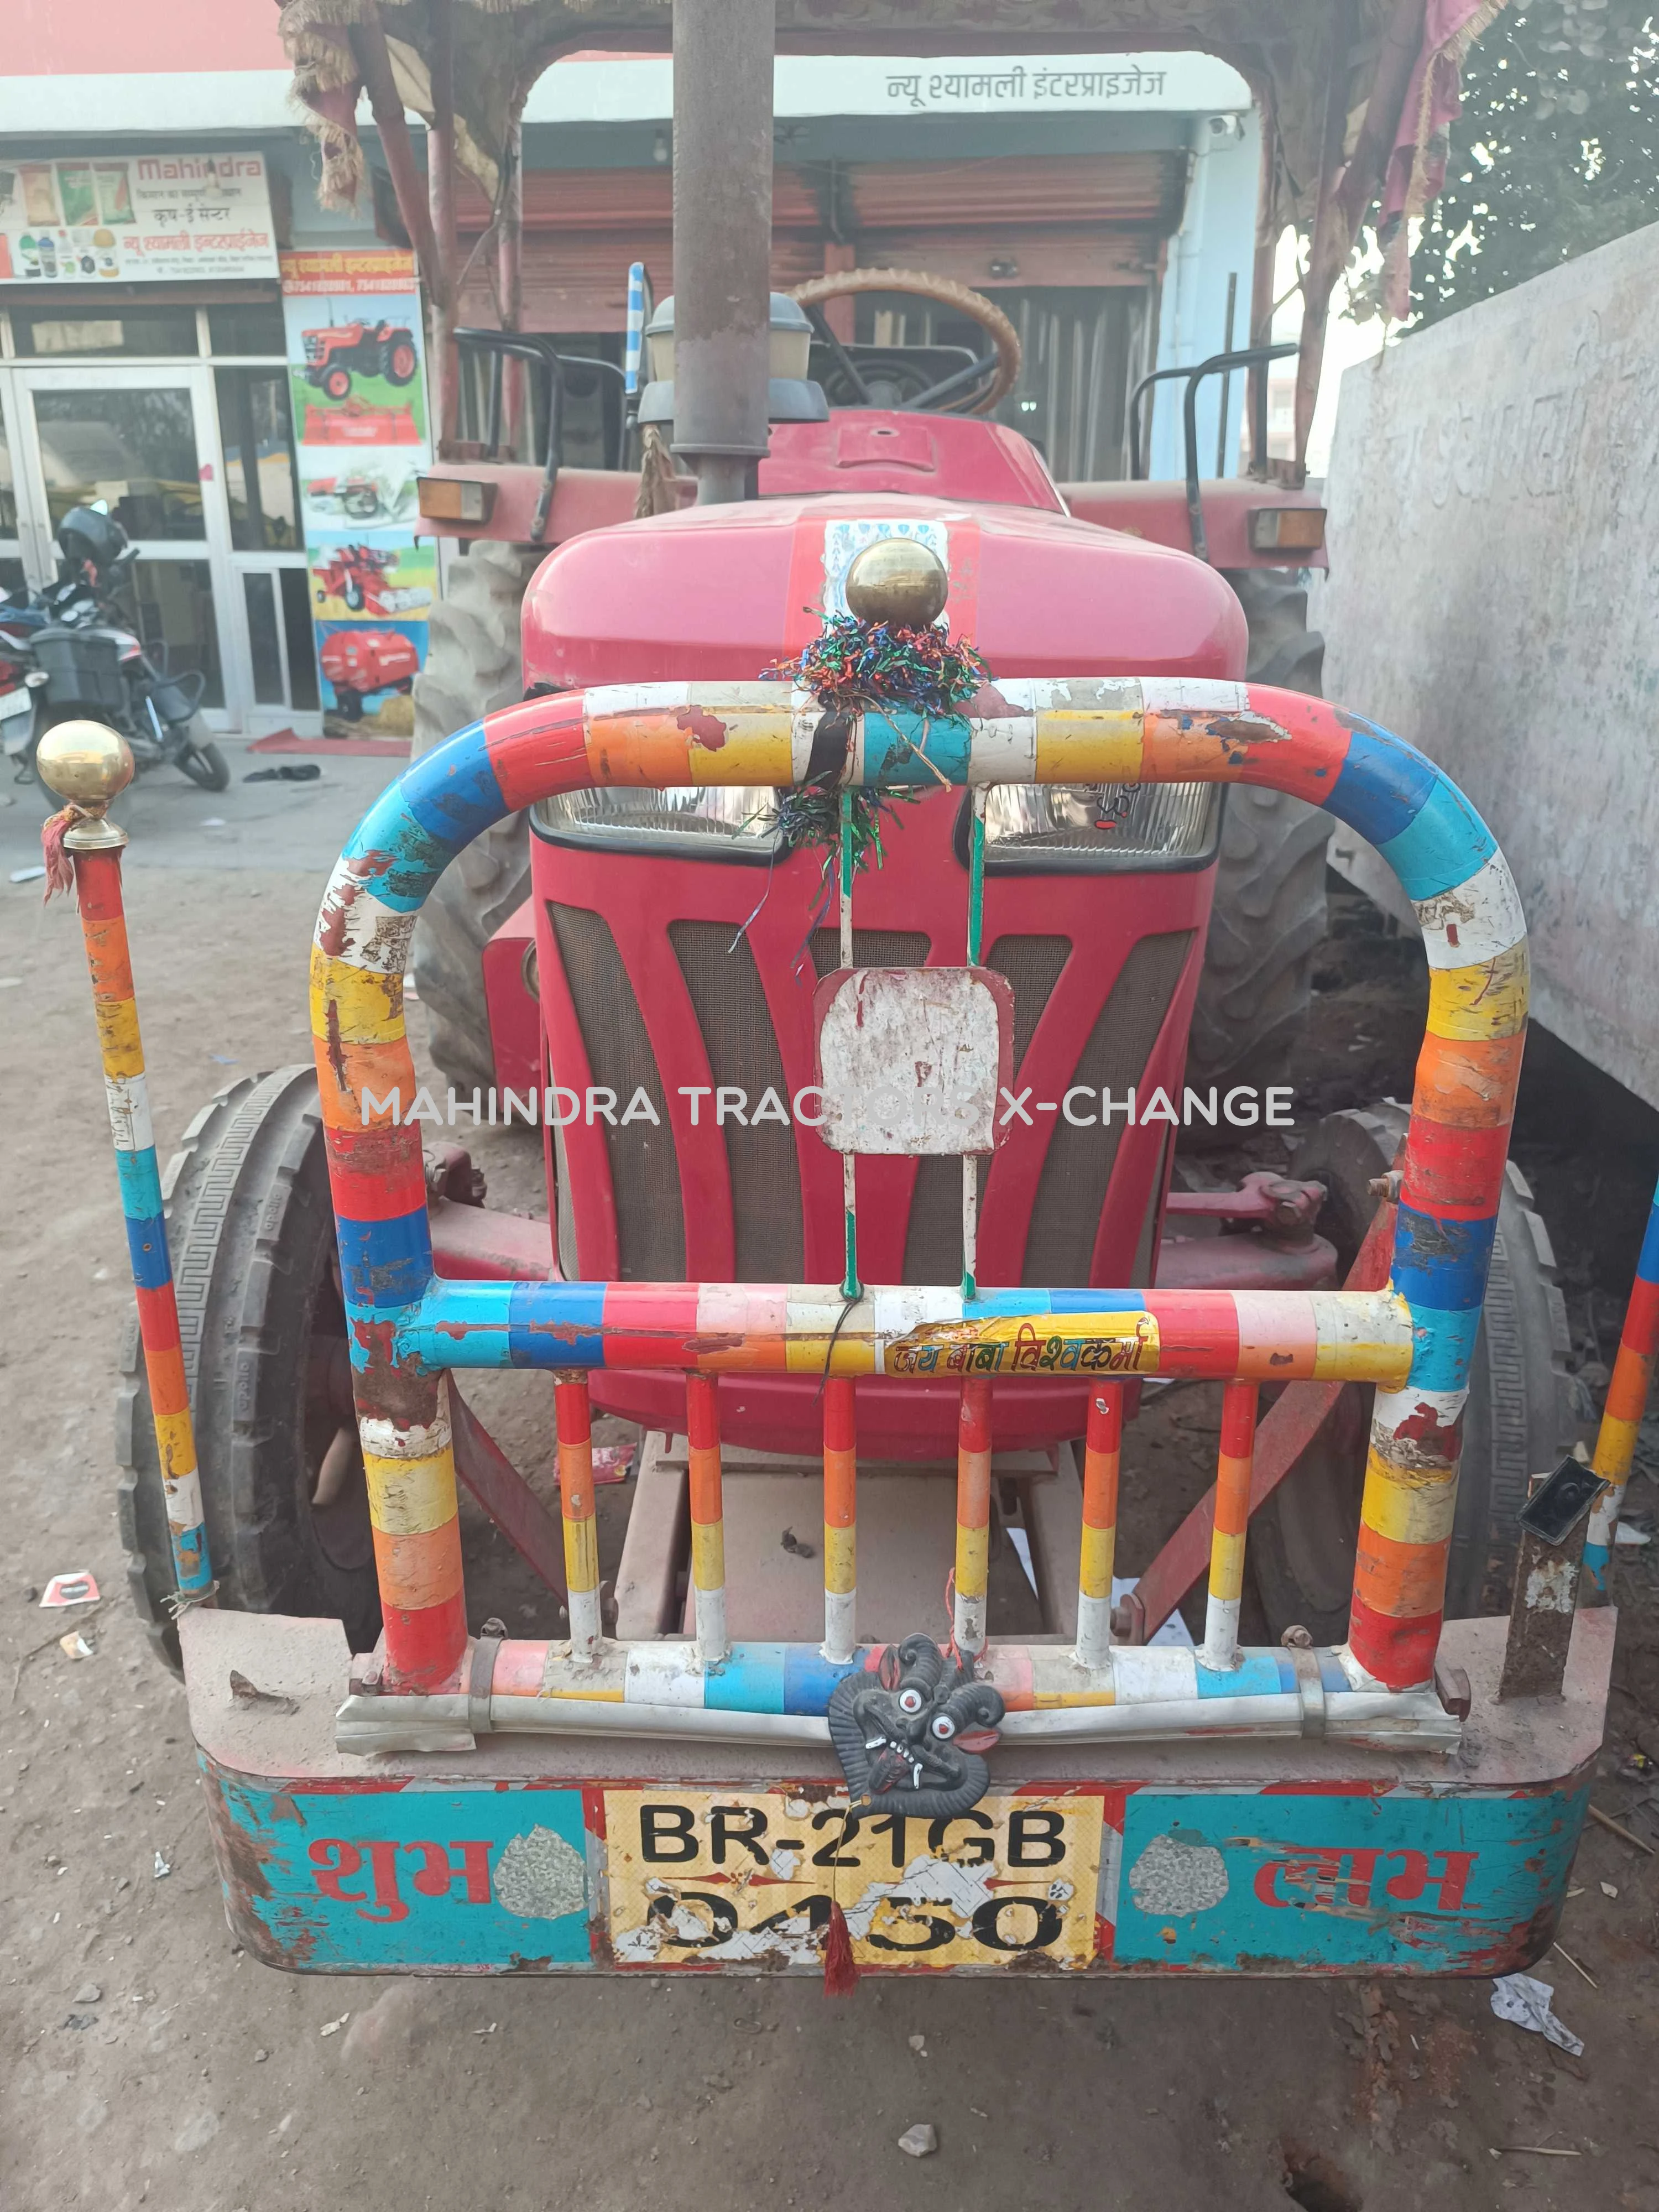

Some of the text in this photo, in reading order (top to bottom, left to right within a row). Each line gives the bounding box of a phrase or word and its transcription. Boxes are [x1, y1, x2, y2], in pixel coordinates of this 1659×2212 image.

[886, 64, 1167, 107] न्यू श्यामली इंटरप्राइजेज
[895, 1343, 945, 1374] जय
[946, 1340, 1010, 1373] बाबा
[1014, 1322, 1150, 1373] विश्वकर्मा
[640, 1804, 1066, 1868] BR-21GB
[307, 1837, 494, 1923] शुभ
[1254, 1846, 1480, 1911] लाभ
